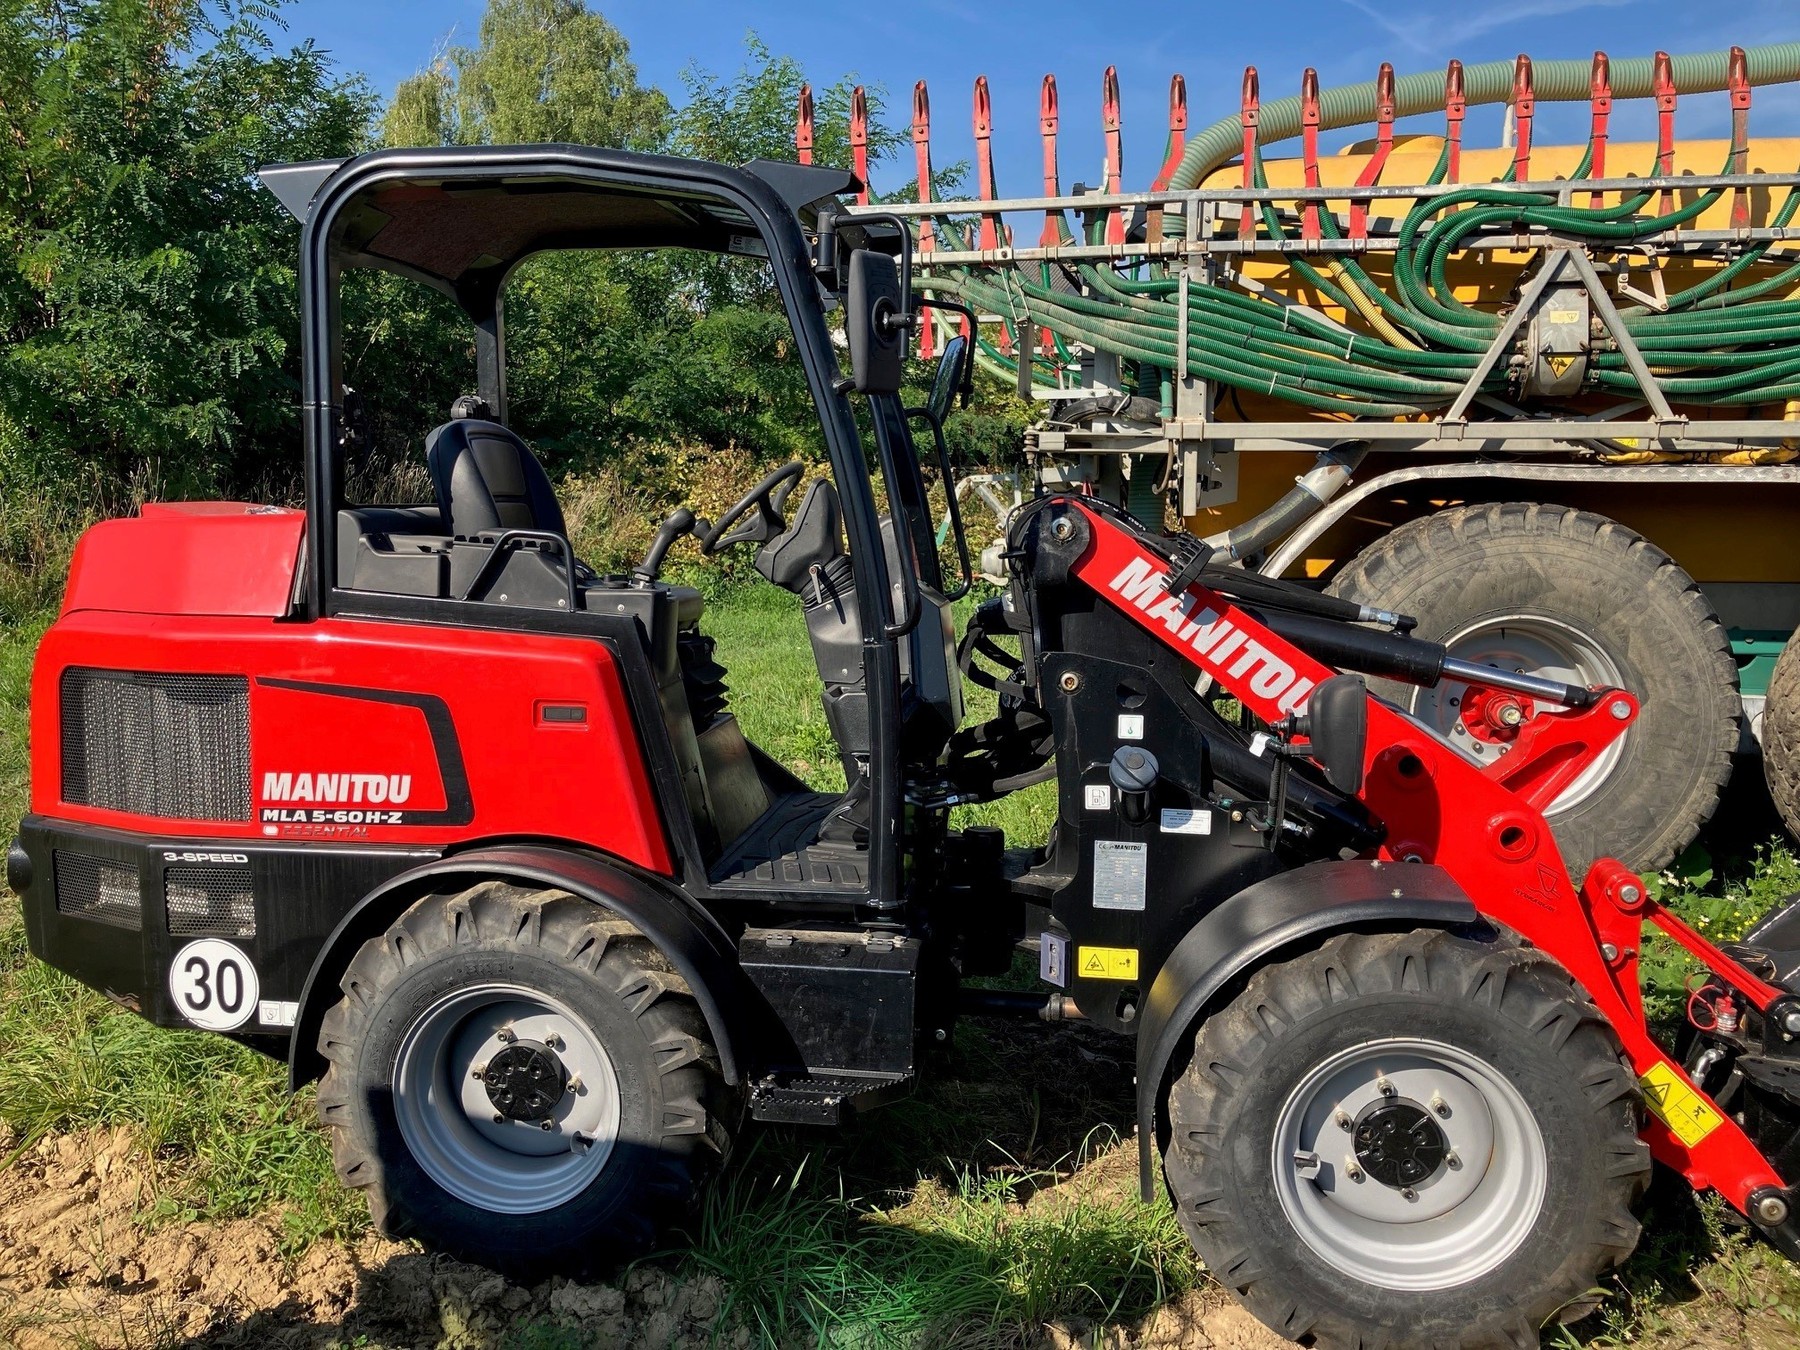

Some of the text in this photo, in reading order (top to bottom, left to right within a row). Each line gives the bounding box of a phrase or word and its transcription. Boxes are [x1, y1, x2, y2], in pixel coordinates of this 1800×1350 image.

[1108, 556, 1315, 717] MANITOU
[262, 772, 411, 804] MANITOU
[263, 809, 307, 823] MLA
[283, 825, 369, 838] ESSENTIAL
[163, 852, 249, 864] 3-SPEED
[184, 956, 244, 1014] 30
